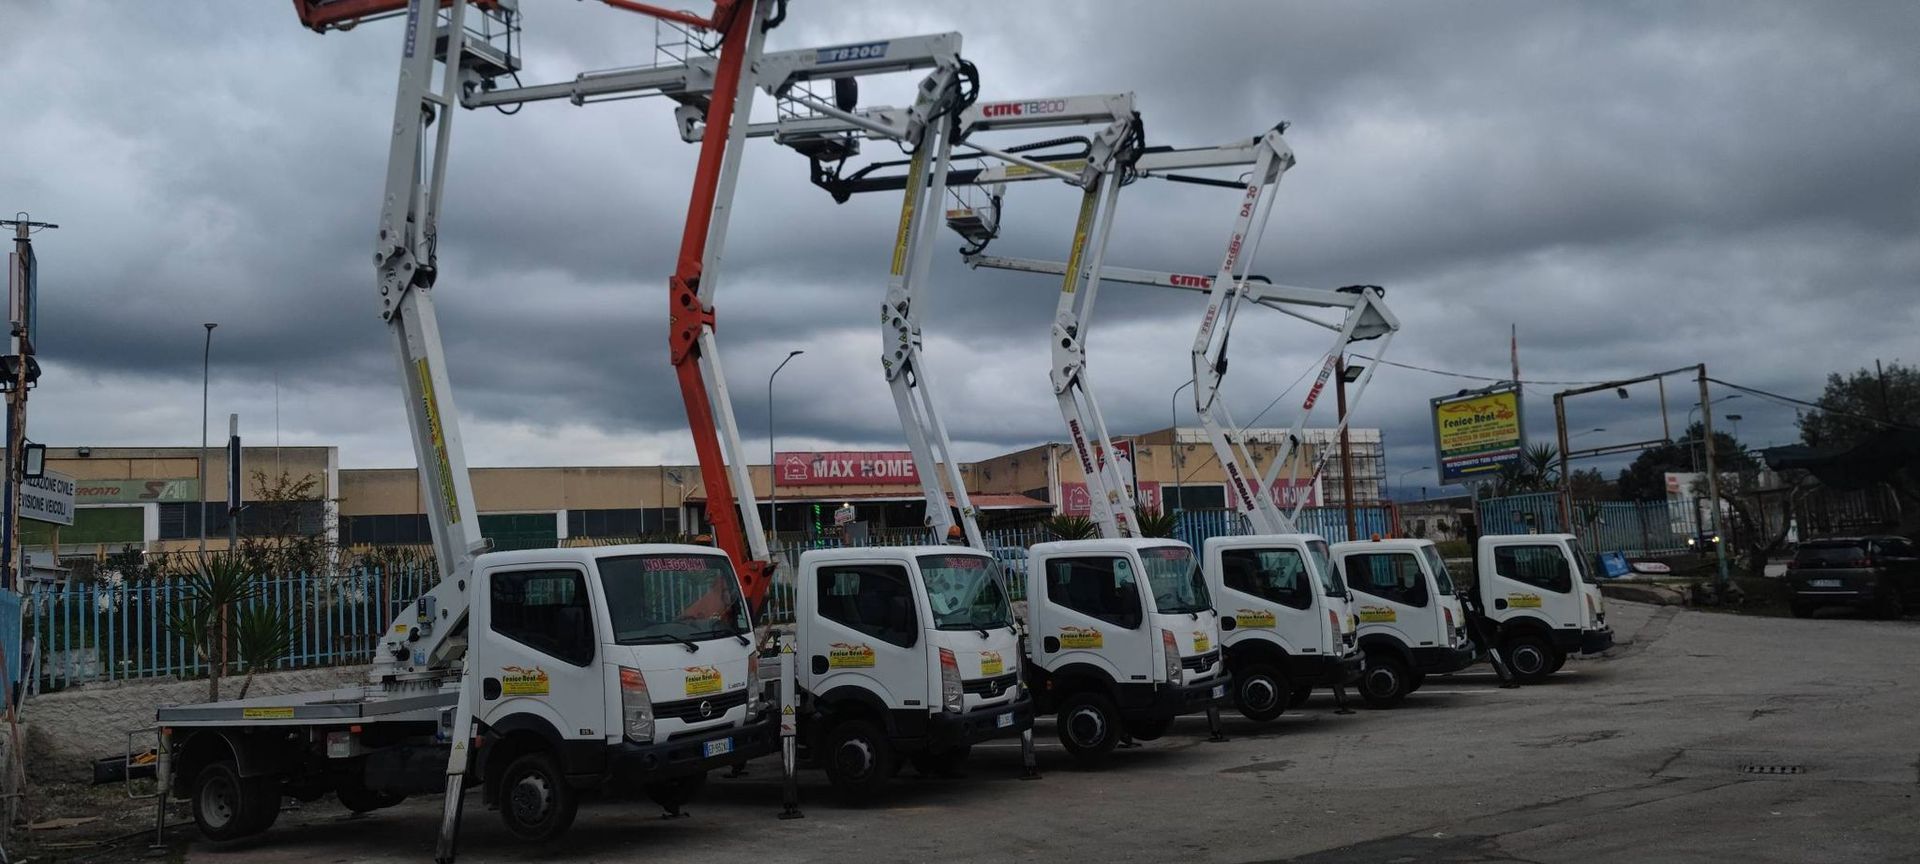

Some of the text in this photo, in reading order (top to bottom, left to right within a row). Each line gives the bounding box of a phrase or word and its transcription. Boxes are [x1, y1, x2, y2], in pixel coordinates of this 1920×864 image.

[831, 45, 881, 61] TB200
[1240, 202, 1252, 218] DA
[1247, 186, 1258, 199] 20
[1474, 411, 1496, 424] Rent
[1069, 419, 1094, 475] NOLEGGIAMI
[813, 459, 913, 478] MAX HOME
[57, 480, 74, 496] CIVILE
[1226, 461, 1255, 511] NOLEGGIAMI
[45, 499, 66, 515] VEICOLI
